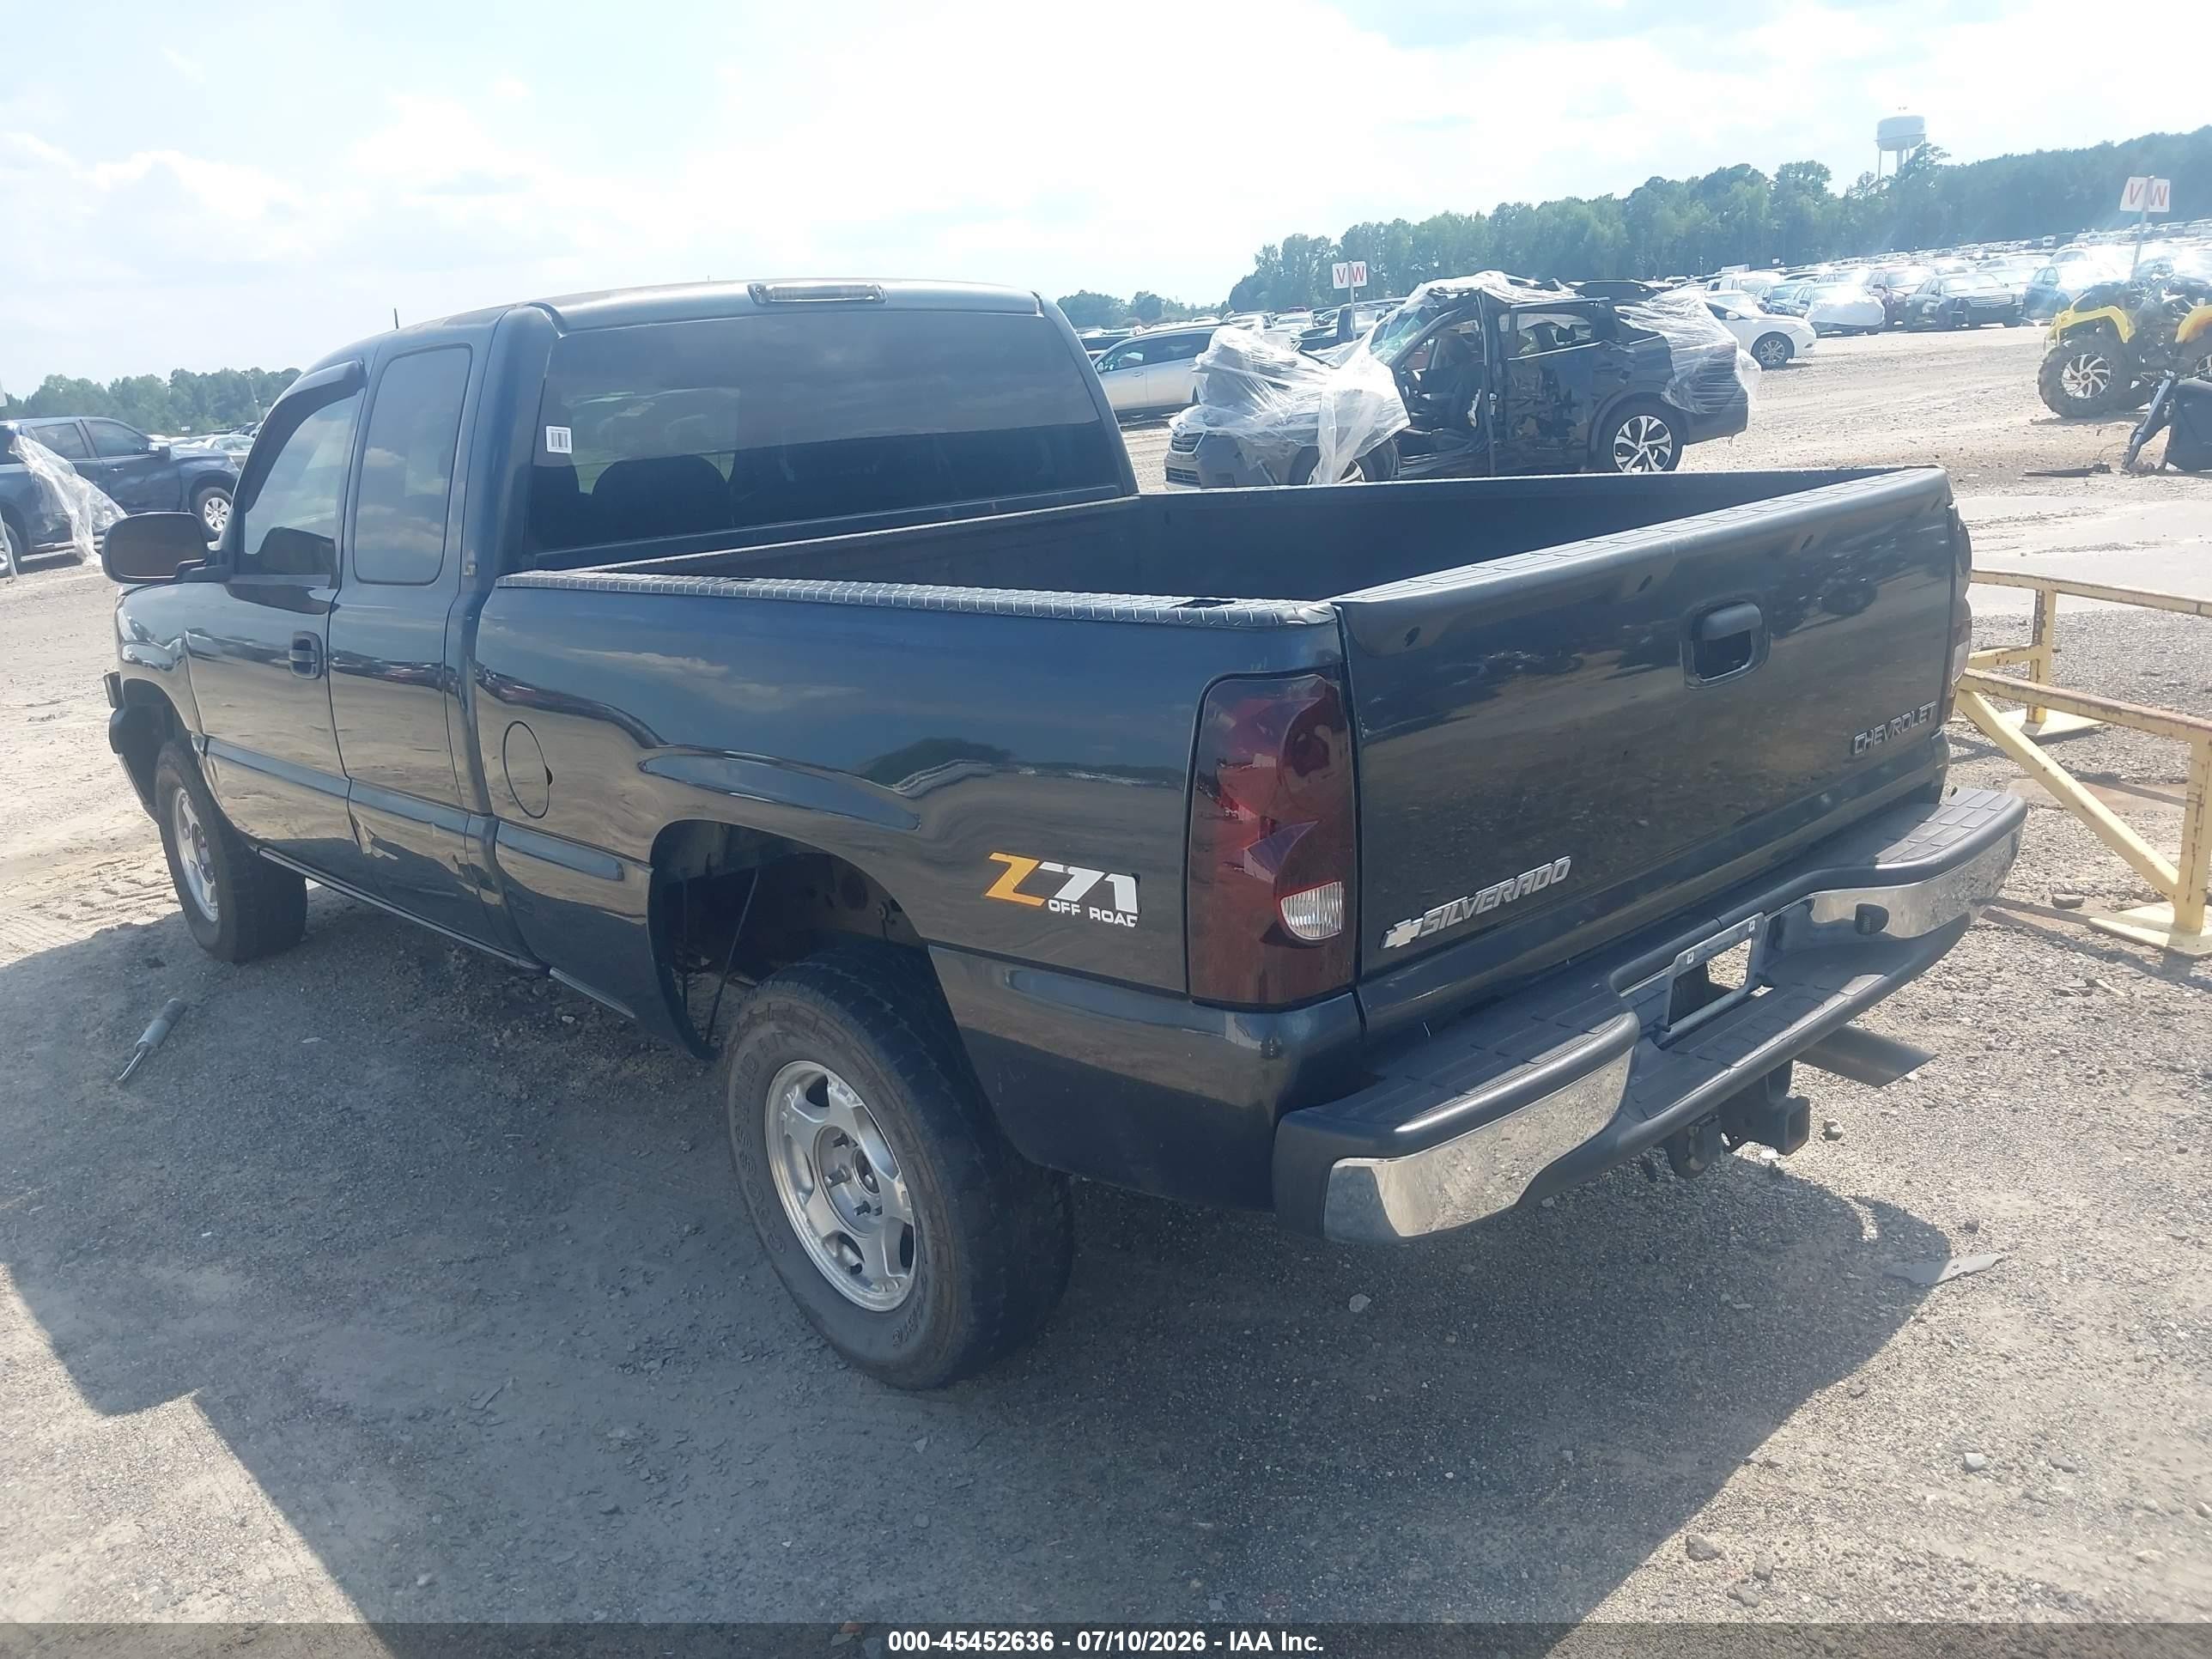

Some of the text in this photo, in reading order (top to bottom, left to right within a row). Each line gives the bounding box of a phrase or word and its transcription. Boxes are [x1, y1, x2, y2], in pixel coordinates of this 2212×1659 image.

[2129, 183, 2168, 206] V W
[1336, 265, 1365, 283] V W
[1853, 700, 1937, 754] CHEVROLET
[984, 851, 1139, 915] Z71
[1419, 855, 1571, 938] SILVERADO
[1048, 899, 1082, 916] OFF
